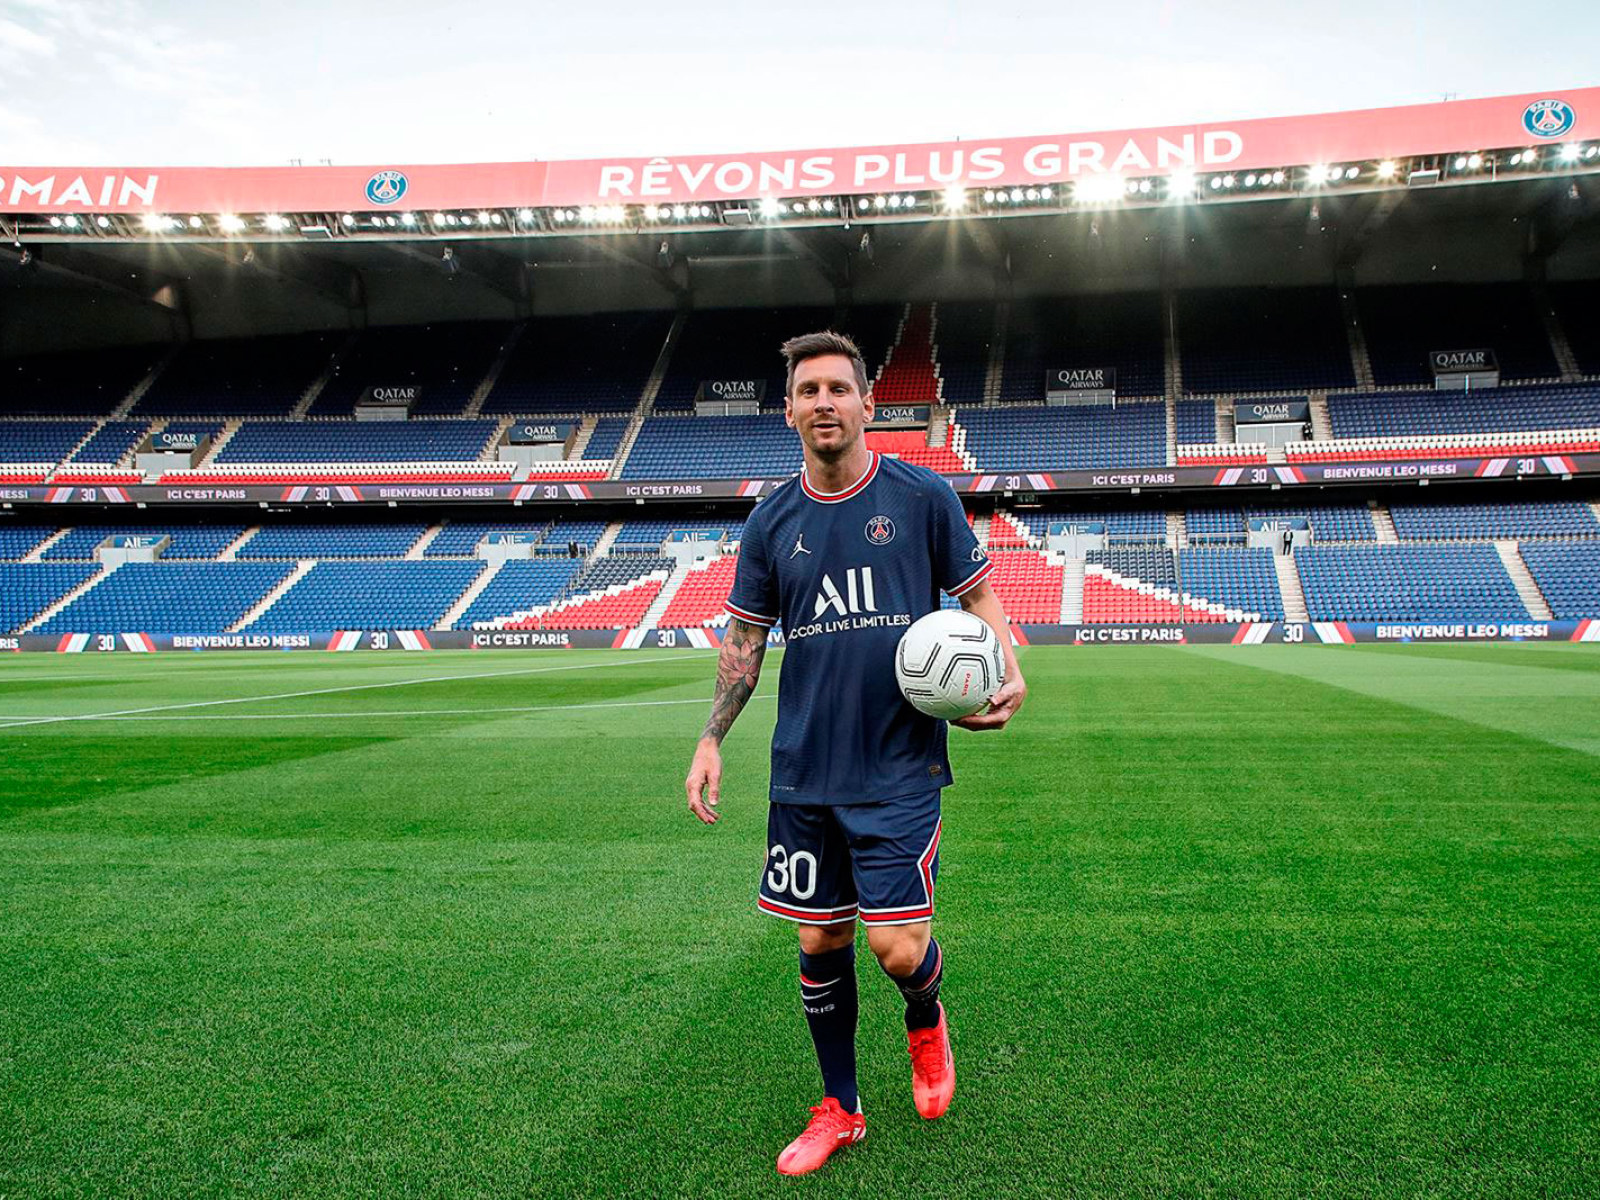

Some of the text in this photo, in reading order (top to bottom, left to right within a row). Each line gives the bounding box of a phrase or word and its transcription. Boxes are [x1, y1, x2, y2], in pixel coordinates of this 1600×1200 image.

[598, 130, 1243, 198] RÊVONS PLUS GRAND
[1436, 351, 1485, 367] QATAR
[1058, 369, 1104, 384] QATAR
[712, 381, 755, 395] QATAR
[1070, 379, 1104, 389] AIRWAYS
[373, 387, 415, 400] QATAR
[882, 408, 915, 419] QATAR
[1253, 404, 1289, 416] QATAR
[524, 425, 557, 437] QATAR
[162, 433, 197, 444] QATAR
[1323, 464, 1457, 479] BIENVENUE LEO MESSI
[1517, 459, 1535, 474] 30
[1005, 476, 1020, 489] 30
[1092, 474, 1175, 485] ICI C'EST PARIS
[1251, 469, 1267, 483] 30
[81, 488, 97, 502] 30
[167, 490, 246, 499] ICI C'EST PARIS
[315, 487, 330, 500] 30
[379, 487, 494, 497] BIENVENUE LEO MESSI
[544, 485, 558, 499] 30
[626, 485, 702, 496] ICI C'EST PARIS
[825, 620, 850, 633] LIVE
[853, 614, 911, 628] LIMITLESS
[1075, 628, 1184, 641] ICI C'EST PARIS
[1282, 624, 1303, 642] 30
[1376, 623, 1548, 639] BIENVENUE LEO MESSI
[97, 634, 115, 651] 30
[173, 635, 310, 647] BIENVENUE LEO MESSI
[370, 632, 389, 649] 30
[473, 633, 569, 645] ICI C'EST PARIS
[657, 630, 675, 647] 30
[767, 844, 817, 900] 30
